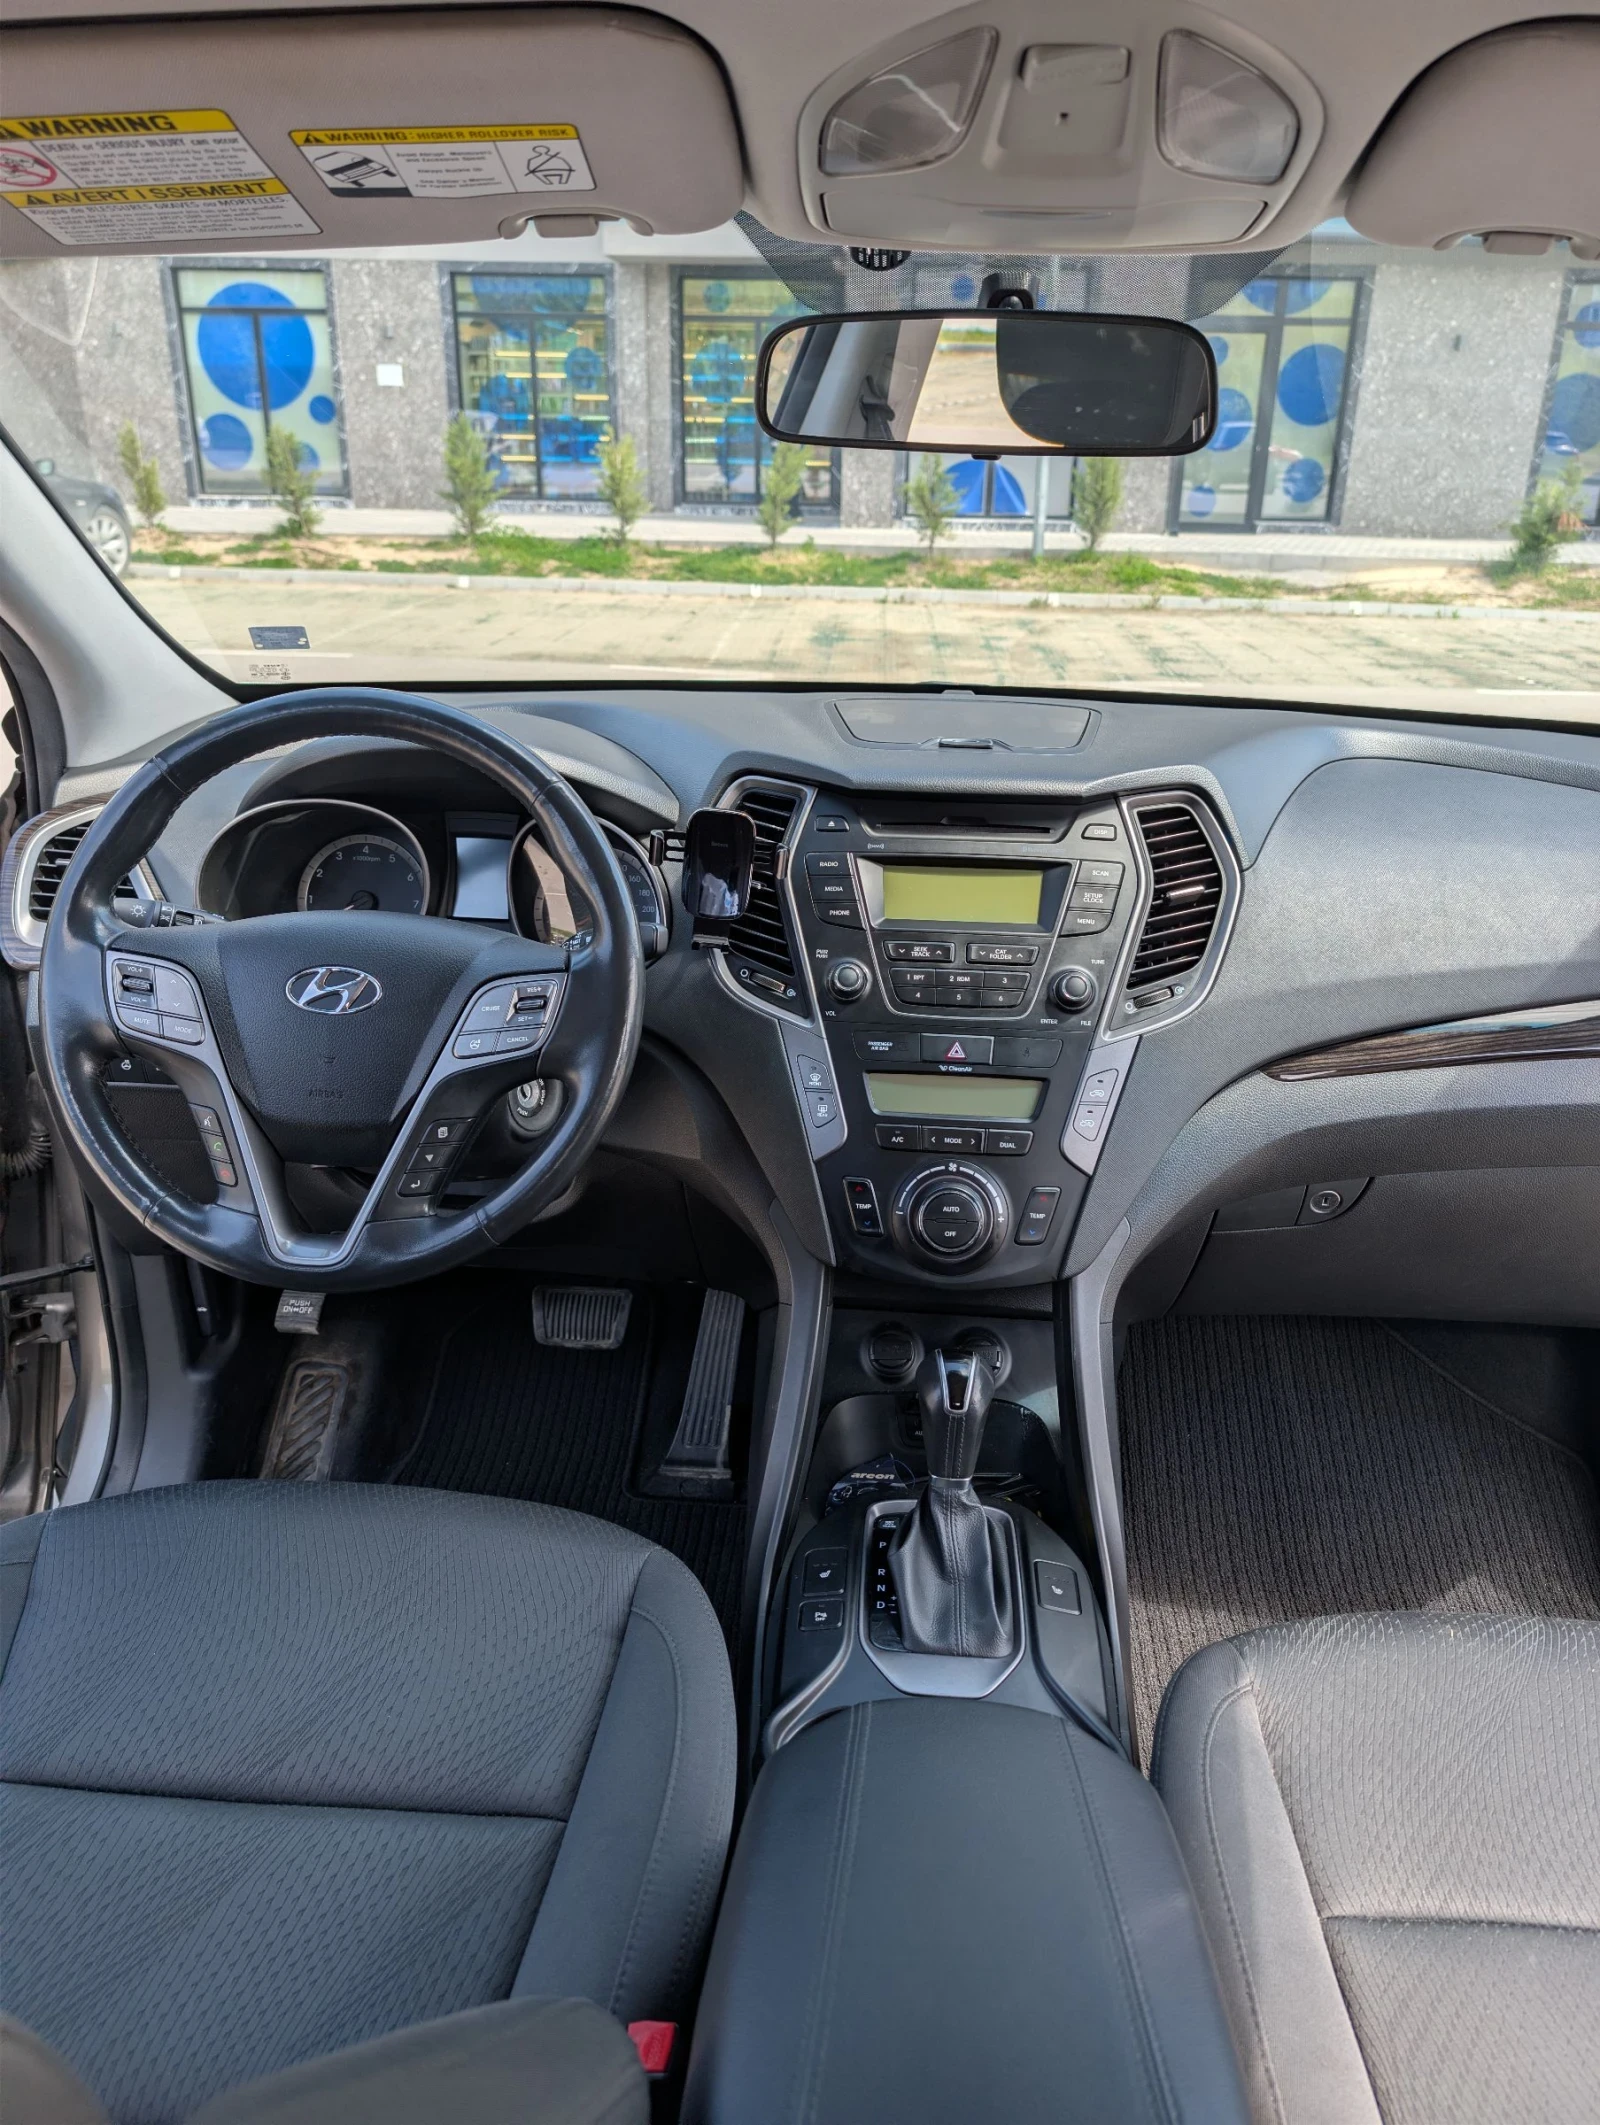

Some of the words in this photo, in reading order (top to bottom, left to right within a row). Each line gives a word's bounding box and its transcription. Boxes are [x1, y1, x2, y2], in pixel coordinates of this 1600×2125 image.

[19, 115, 178, 137] WARNING
[416, 131, 465, 140] HIGHER
[469, 129, 534, 139] ROLLOVER
[538, 129, 569, 137] RISK
[362, 845, 369, 854] 4
[335, 852, 343, 860] 3
[389, 854, 396, 863] 5
[316, 868, 324, 878] 2
[1092, 869, 1110, 877] SCAN
[407, 873, 414, 882] 6
[628, 875, 641, 883] 160
[639, 889, 650, 897] 180
[308, 895, 313, 904] 1
[413, 900, 419, 909] 7
[642, 905, 655, 913] 200
[942, 1205, 960, 1213] AUTO
[289, 1299, 311, 1307] PUSH
[879, 1541, 887, 1549] P
[877, 1568, 886, 1576] R
[876, 1584, 886, 1592] N
[876, 1601, 886, 1609] D
